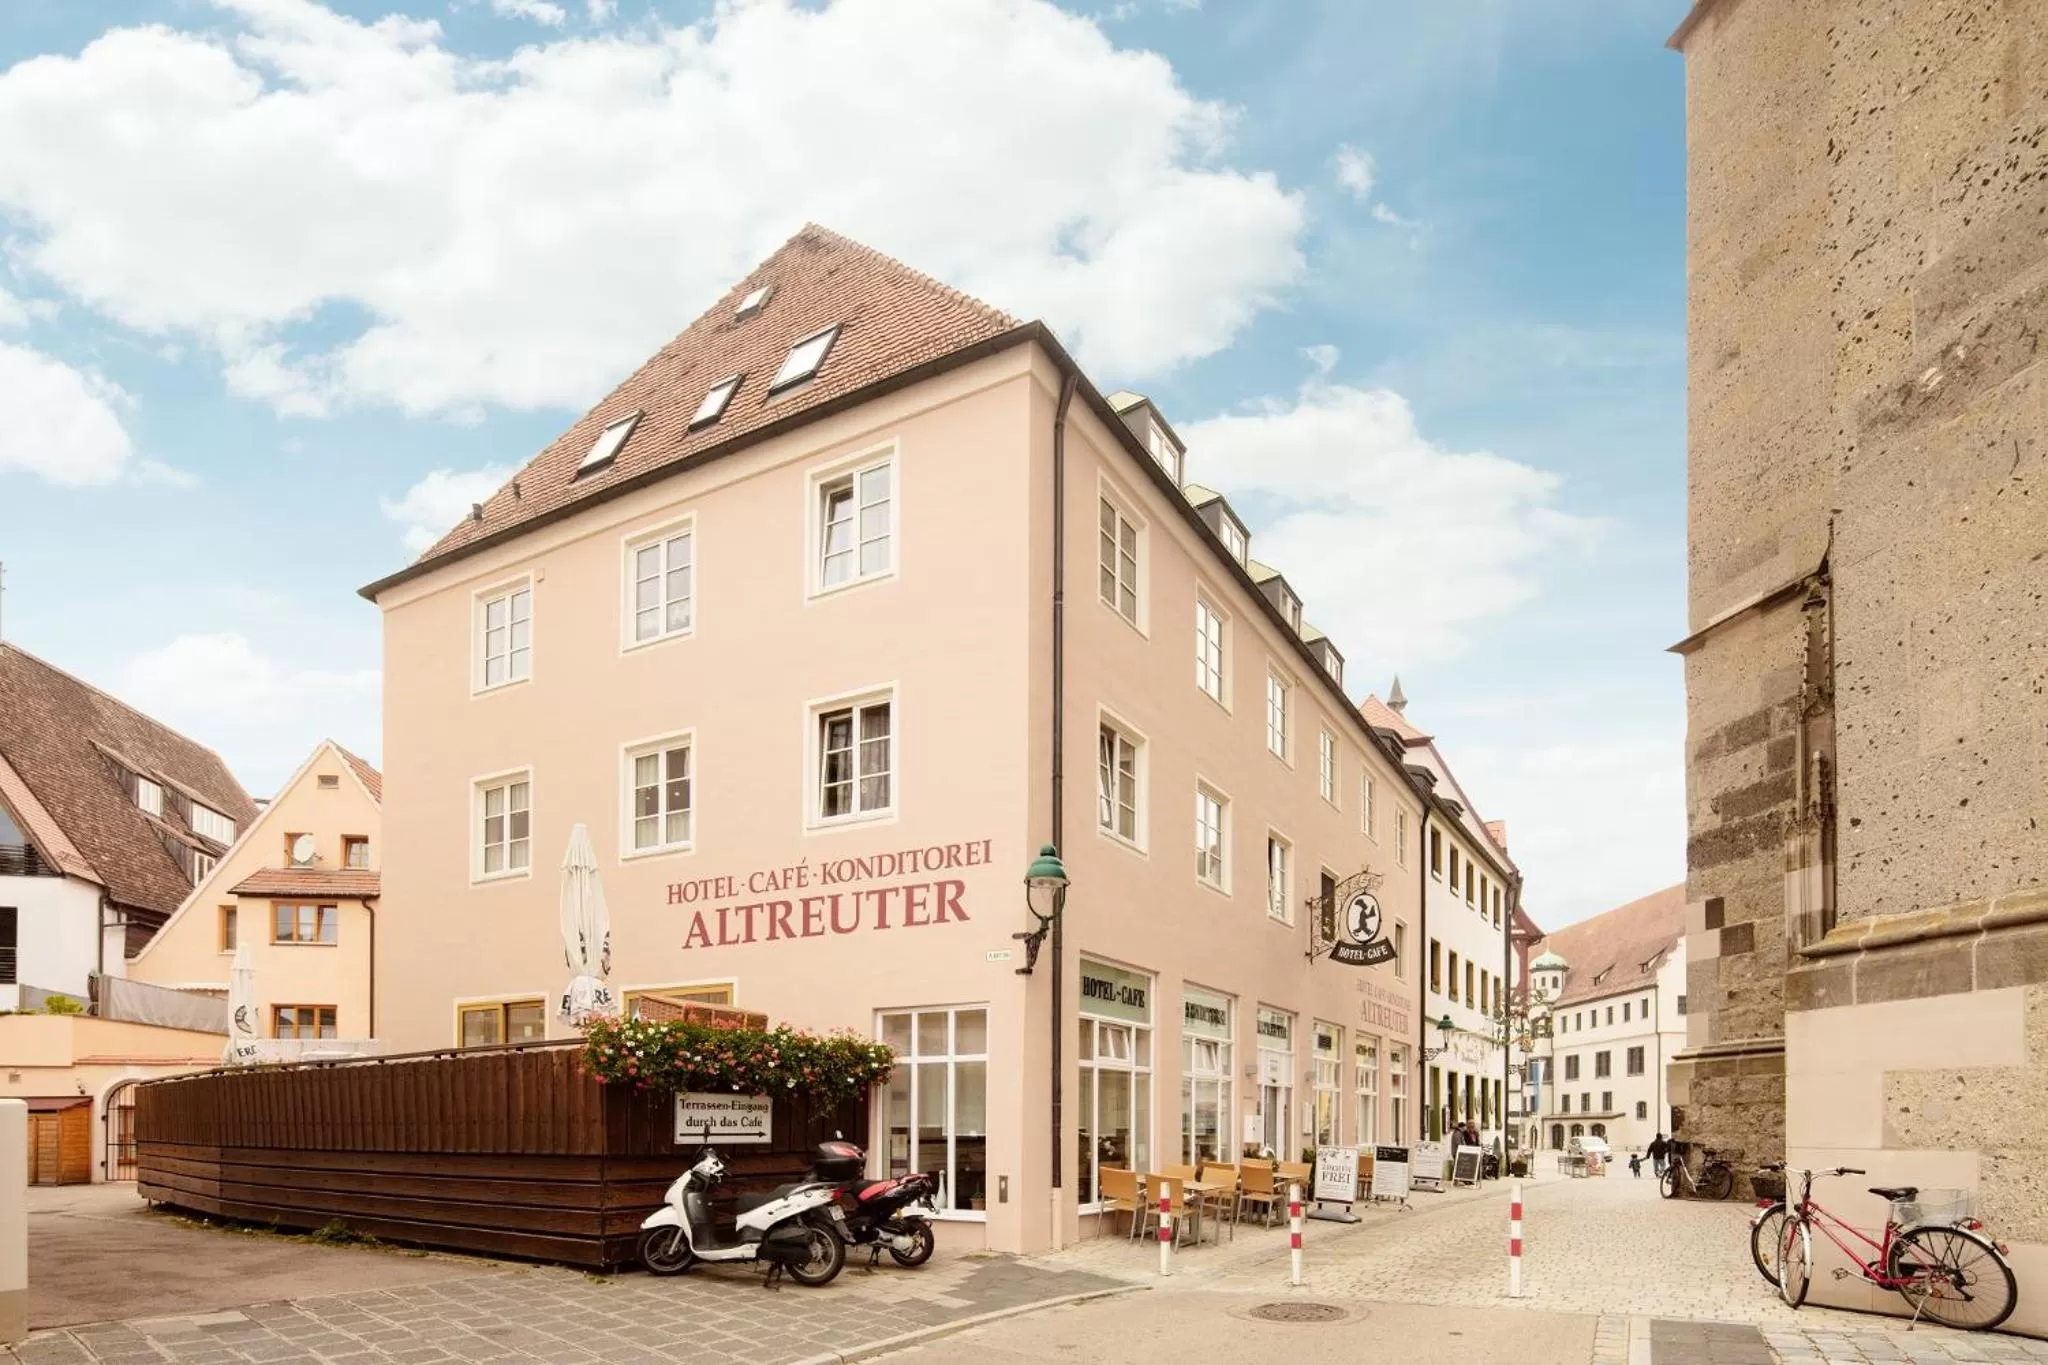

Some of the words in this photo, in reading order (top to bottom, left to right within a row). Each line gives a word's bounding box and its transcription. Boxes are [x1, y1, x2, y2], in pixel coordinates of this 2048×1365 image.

[749, 857, 809, 893] CAFÉ
[820, 839, 992, 885] KONDITOREI
[682, 880, 971, 949] ALTREUTER
[680, 1099, 769, 1113] Terrassen-Eingang
[686, 1116, 716, 1127] durch
[720, 1117, 738, 1127] das
[1322, 1171, 1350, 1184] FREI
